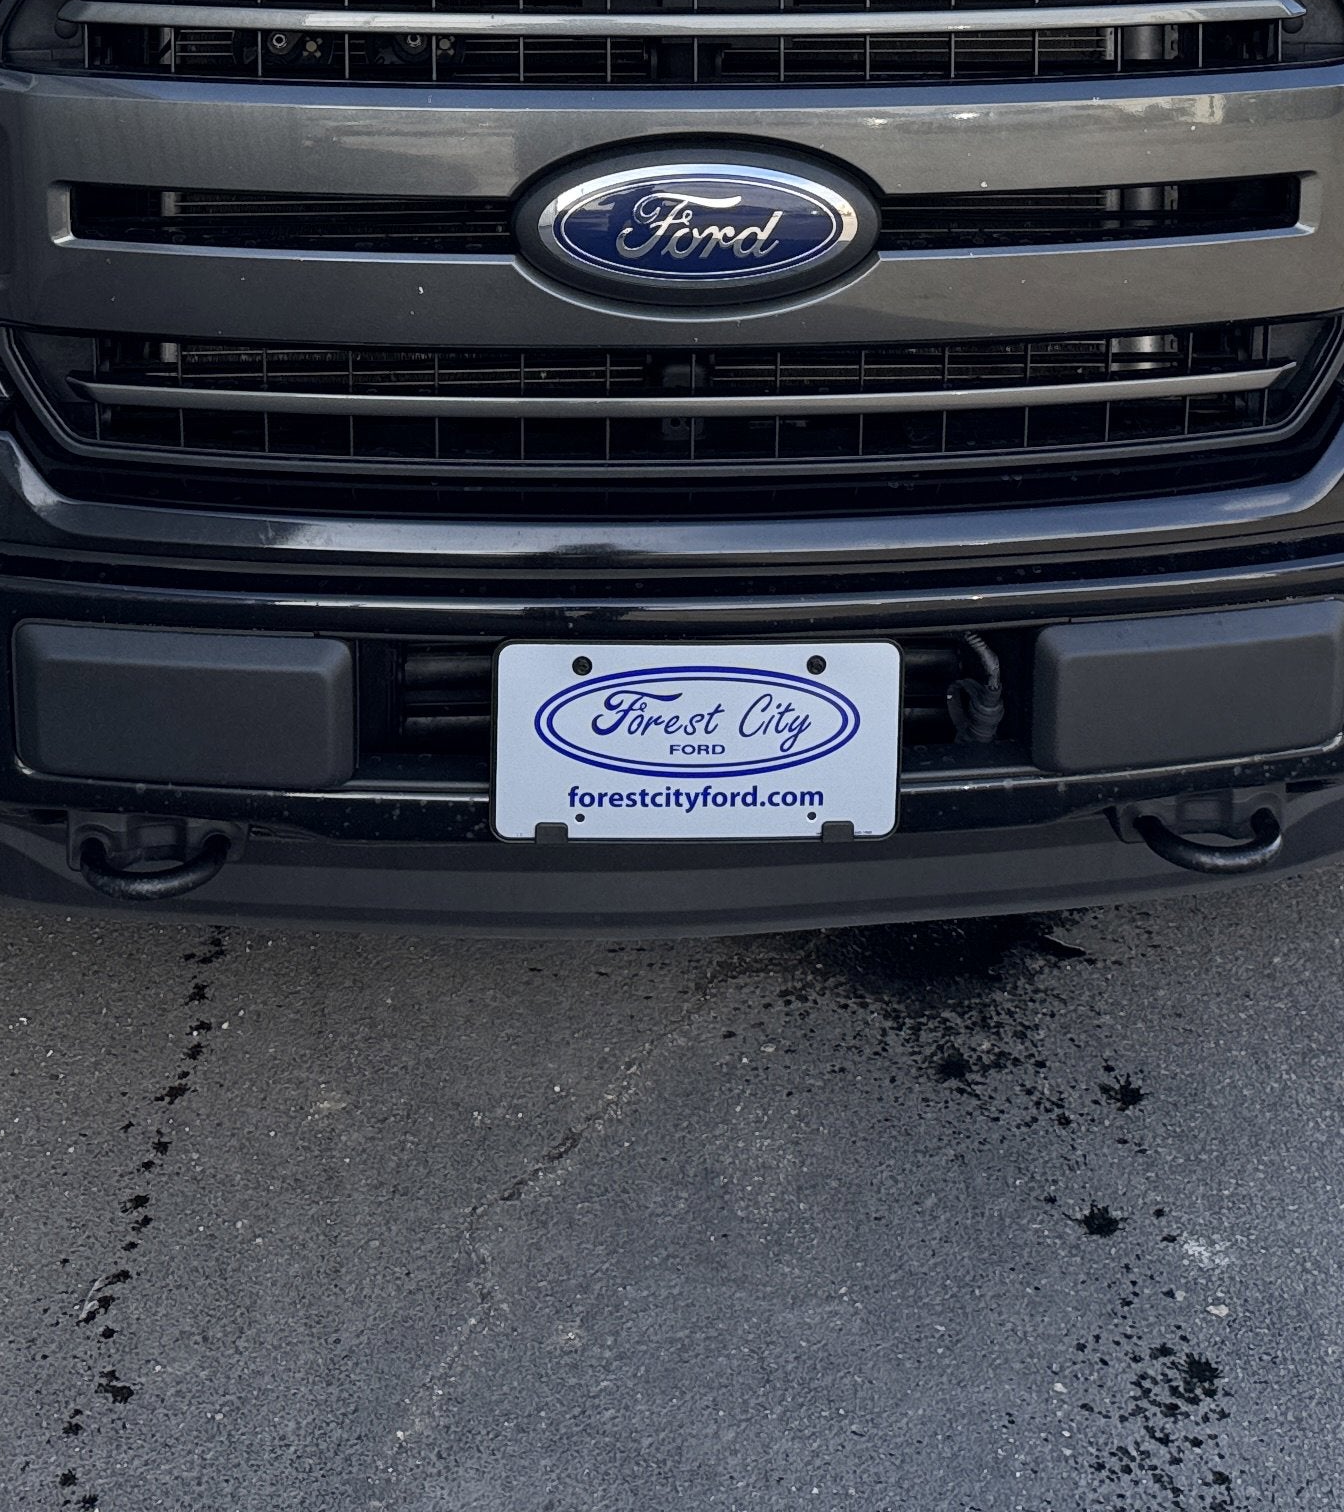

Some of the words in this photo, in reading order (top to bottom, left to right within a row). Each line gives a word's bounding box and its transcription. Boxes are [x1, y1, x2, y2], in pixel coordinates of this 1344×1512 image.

[616, 192, 783, 258] Ford
[591, 690, 725, 736] Forest
[738, 693, 811, 753] City
[669, 744, 726, 755] FORD
[567, 786, 824, 813] forestcityford.com
